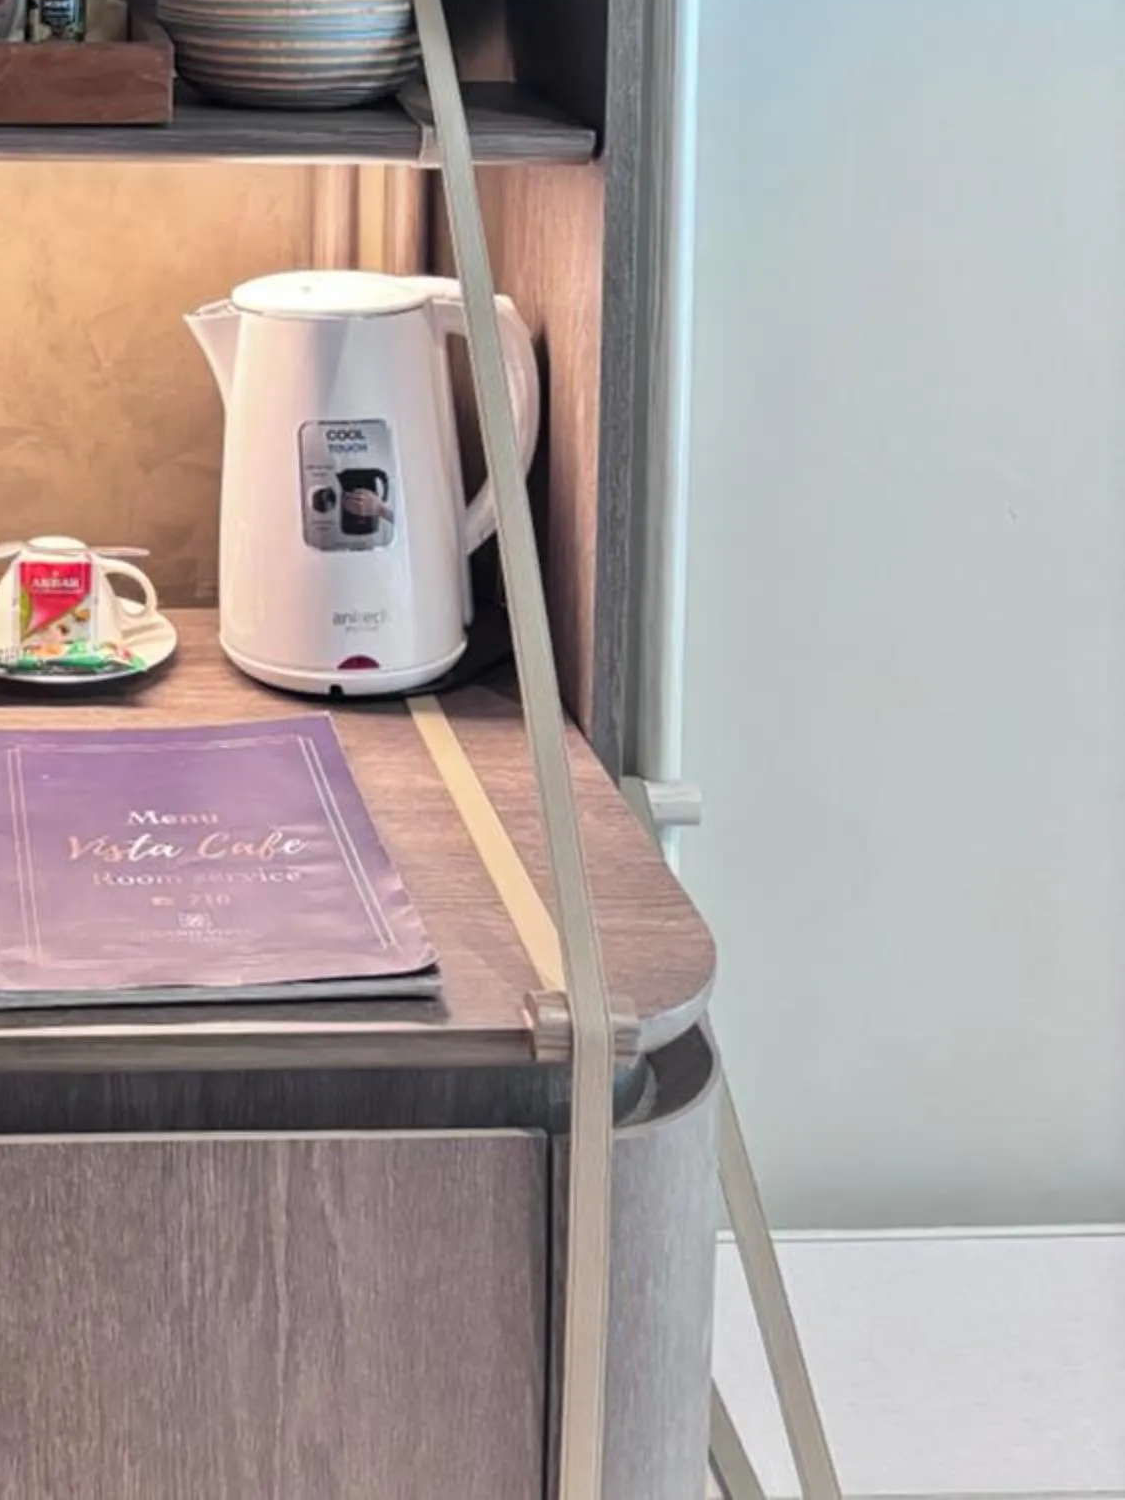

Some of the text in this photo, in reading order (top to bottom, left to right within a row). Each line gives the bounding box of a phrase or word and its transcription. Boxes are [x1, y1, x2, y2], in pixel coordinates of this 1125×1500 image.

[326, 430, 366, 441] COOL
[328, 443, 368, 453] TOUCH
[127, 810, 219, 827] Menu
[67, 831, 184, 863] Vista
[92, 872, 183, 887] Room
